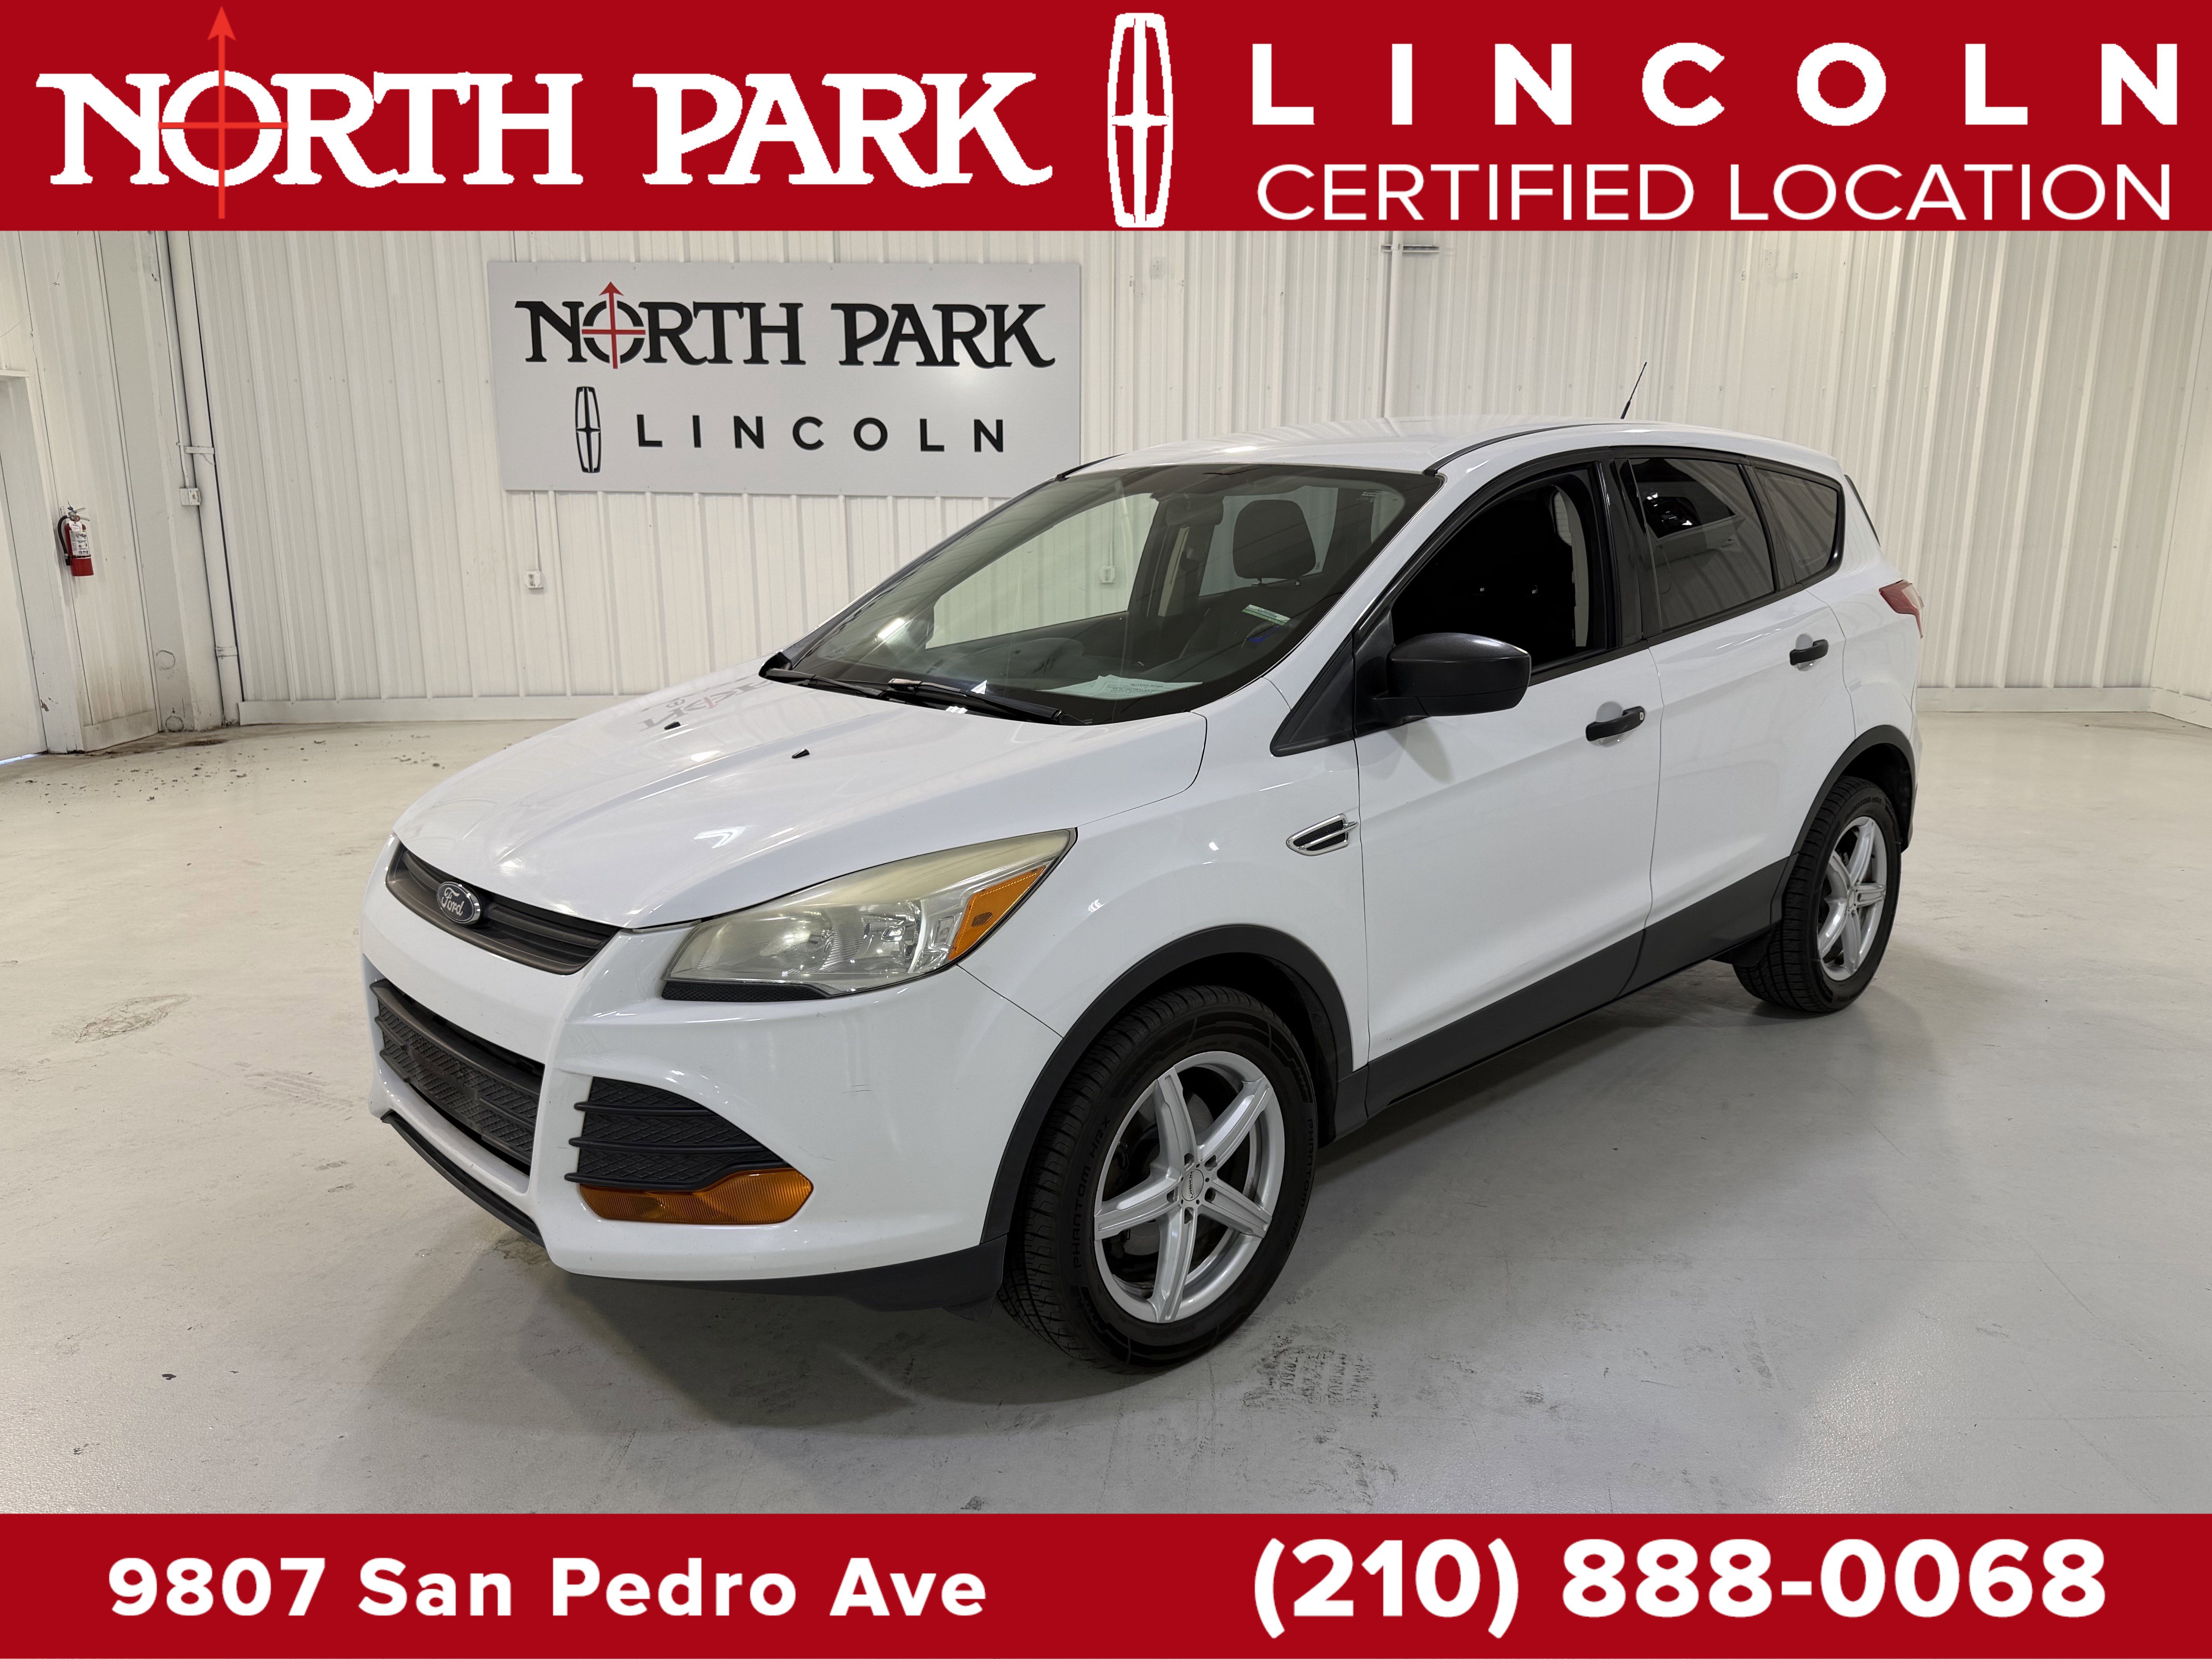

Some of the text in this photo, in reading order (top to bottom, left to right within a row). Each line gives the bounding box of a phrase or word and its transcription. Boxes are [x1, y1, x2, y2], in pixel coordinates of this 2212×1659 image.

[514, 300, 1056, 369] NORTH PARK
[636, 414, 1004, 453] LINCOLN
[441, 887, 464, 916] Ford
[1072, 1164, 1091, 1269] PHANTOM
